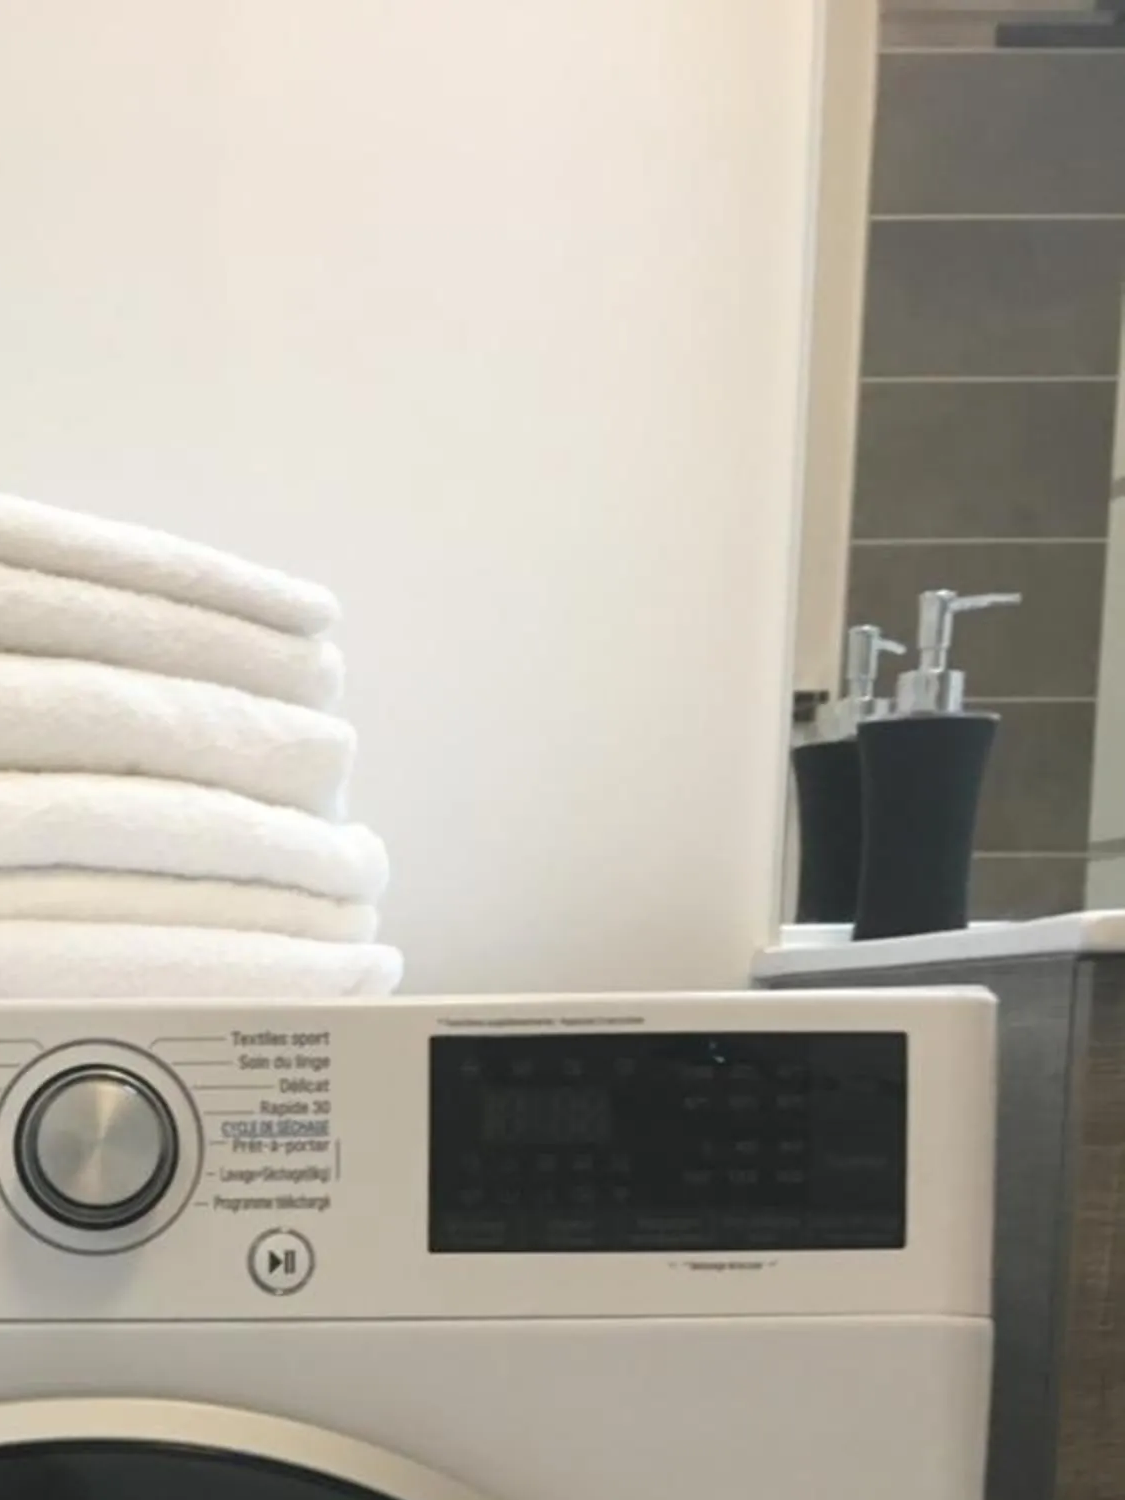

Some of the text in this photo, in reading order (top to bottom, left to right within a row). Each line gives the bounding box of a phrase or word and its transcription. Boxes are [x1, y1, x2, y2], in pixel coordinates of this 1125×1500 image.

[231, 1030, 330, 1048] Textiles sport
[238, 1053, 330, 1072] Soin du linge
[279, 1077, 330, 1093] Délicat
[259, 1100, 331, 1116] Rapide 30
